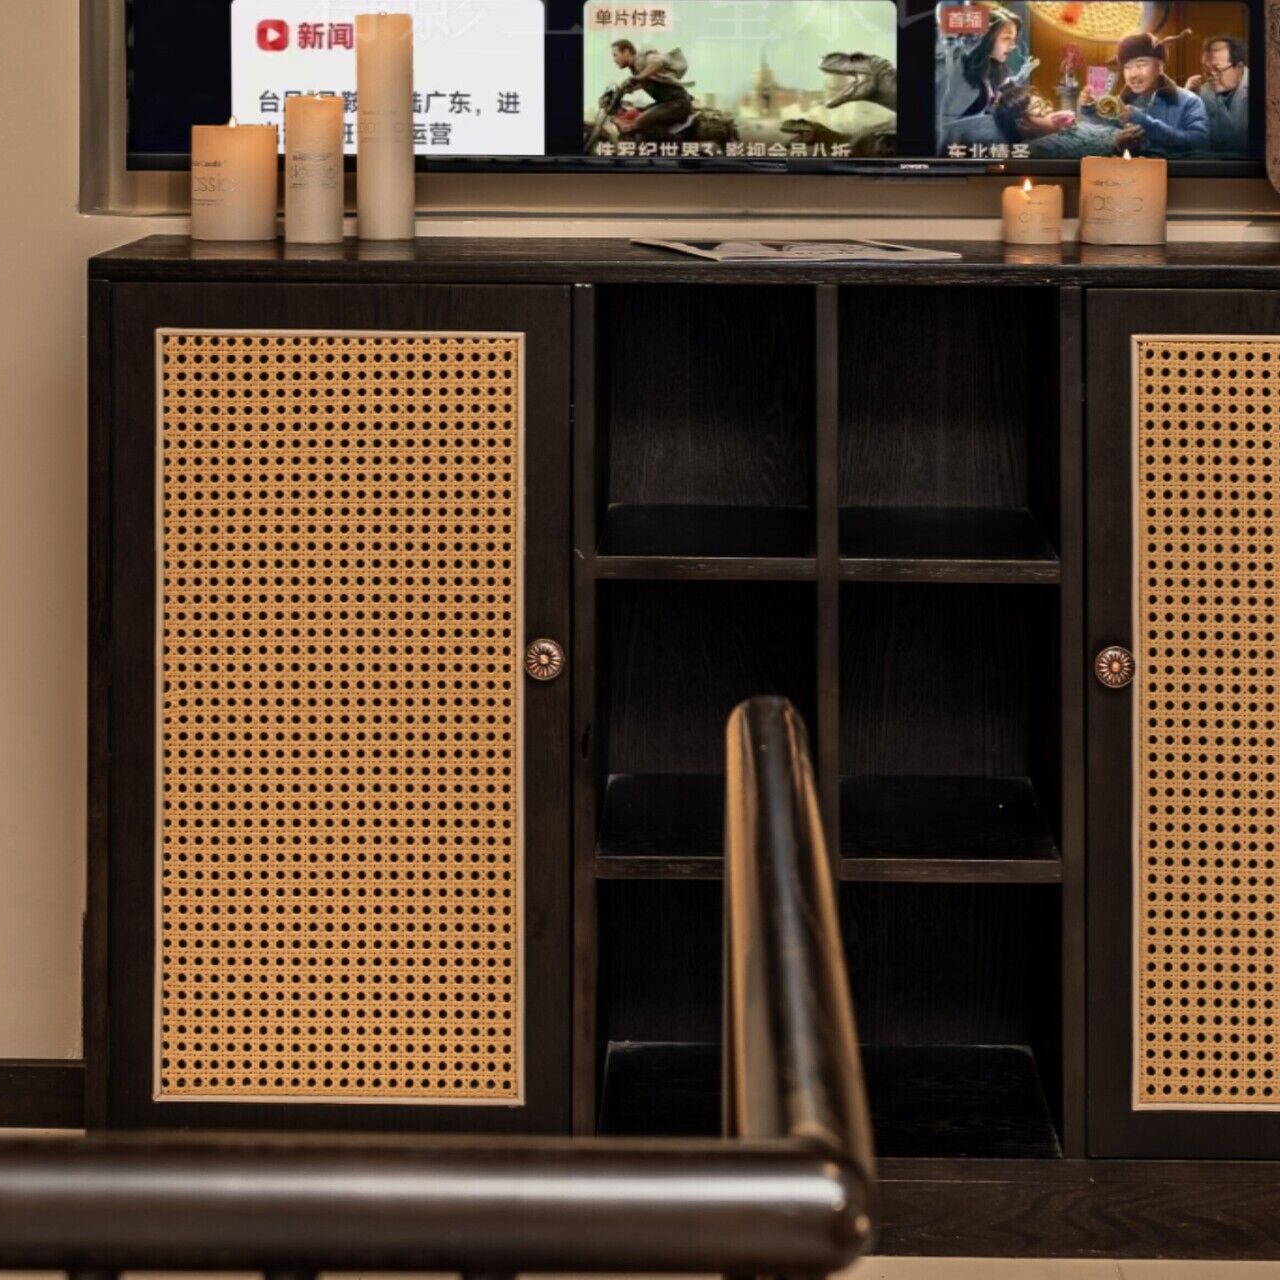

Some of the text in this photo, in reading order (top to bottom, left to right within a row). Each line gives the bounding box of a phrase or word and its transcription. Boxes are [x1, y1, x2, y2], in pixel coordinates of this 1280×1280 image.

[595, 8, 667, 27] 单片付费
[948, 10, 984, 31] 首播
[297, 22, 355, 51] 新闻
